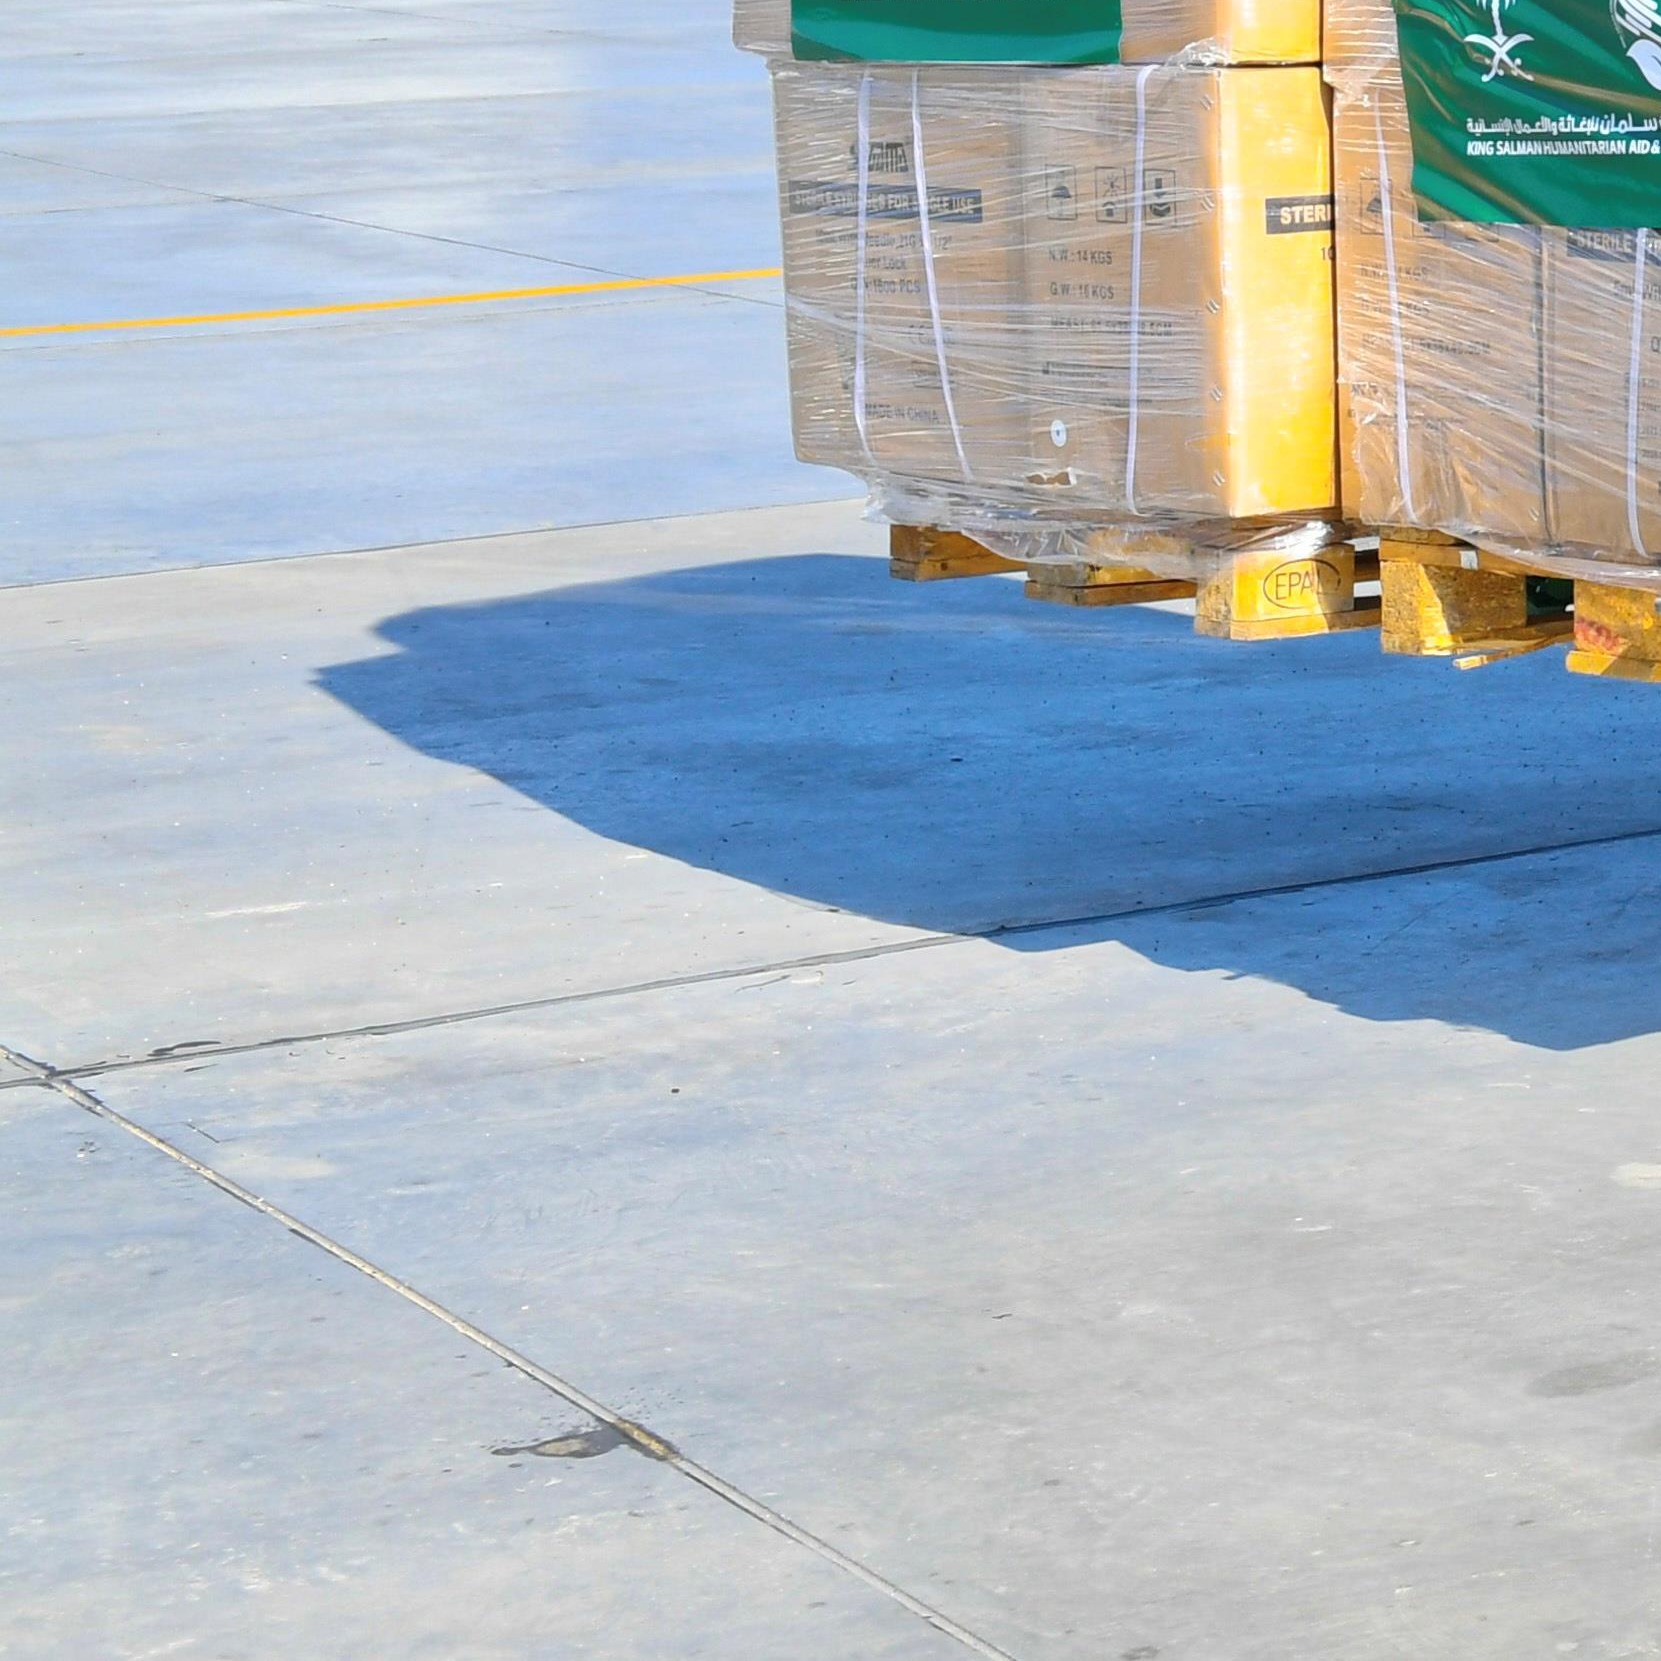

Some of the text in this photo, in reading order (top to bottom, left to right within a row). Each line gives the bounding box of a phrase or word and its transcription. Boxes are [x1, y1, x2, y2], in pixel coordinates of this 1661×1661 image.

[1600, 113, 1658, 134] سلمان
[1467, 141, 1494, 155] KING
[1496, 141, 1542, 155] SALMAN
[1543, 140, 1625, 155] HUMANITARIAN
[1629, 140, 1650, 154] AID
[1651, 140, 1660, 154] &
[1090, 251, 1113, 266] KGS
[1092, 284, 1115, 300] KGS
